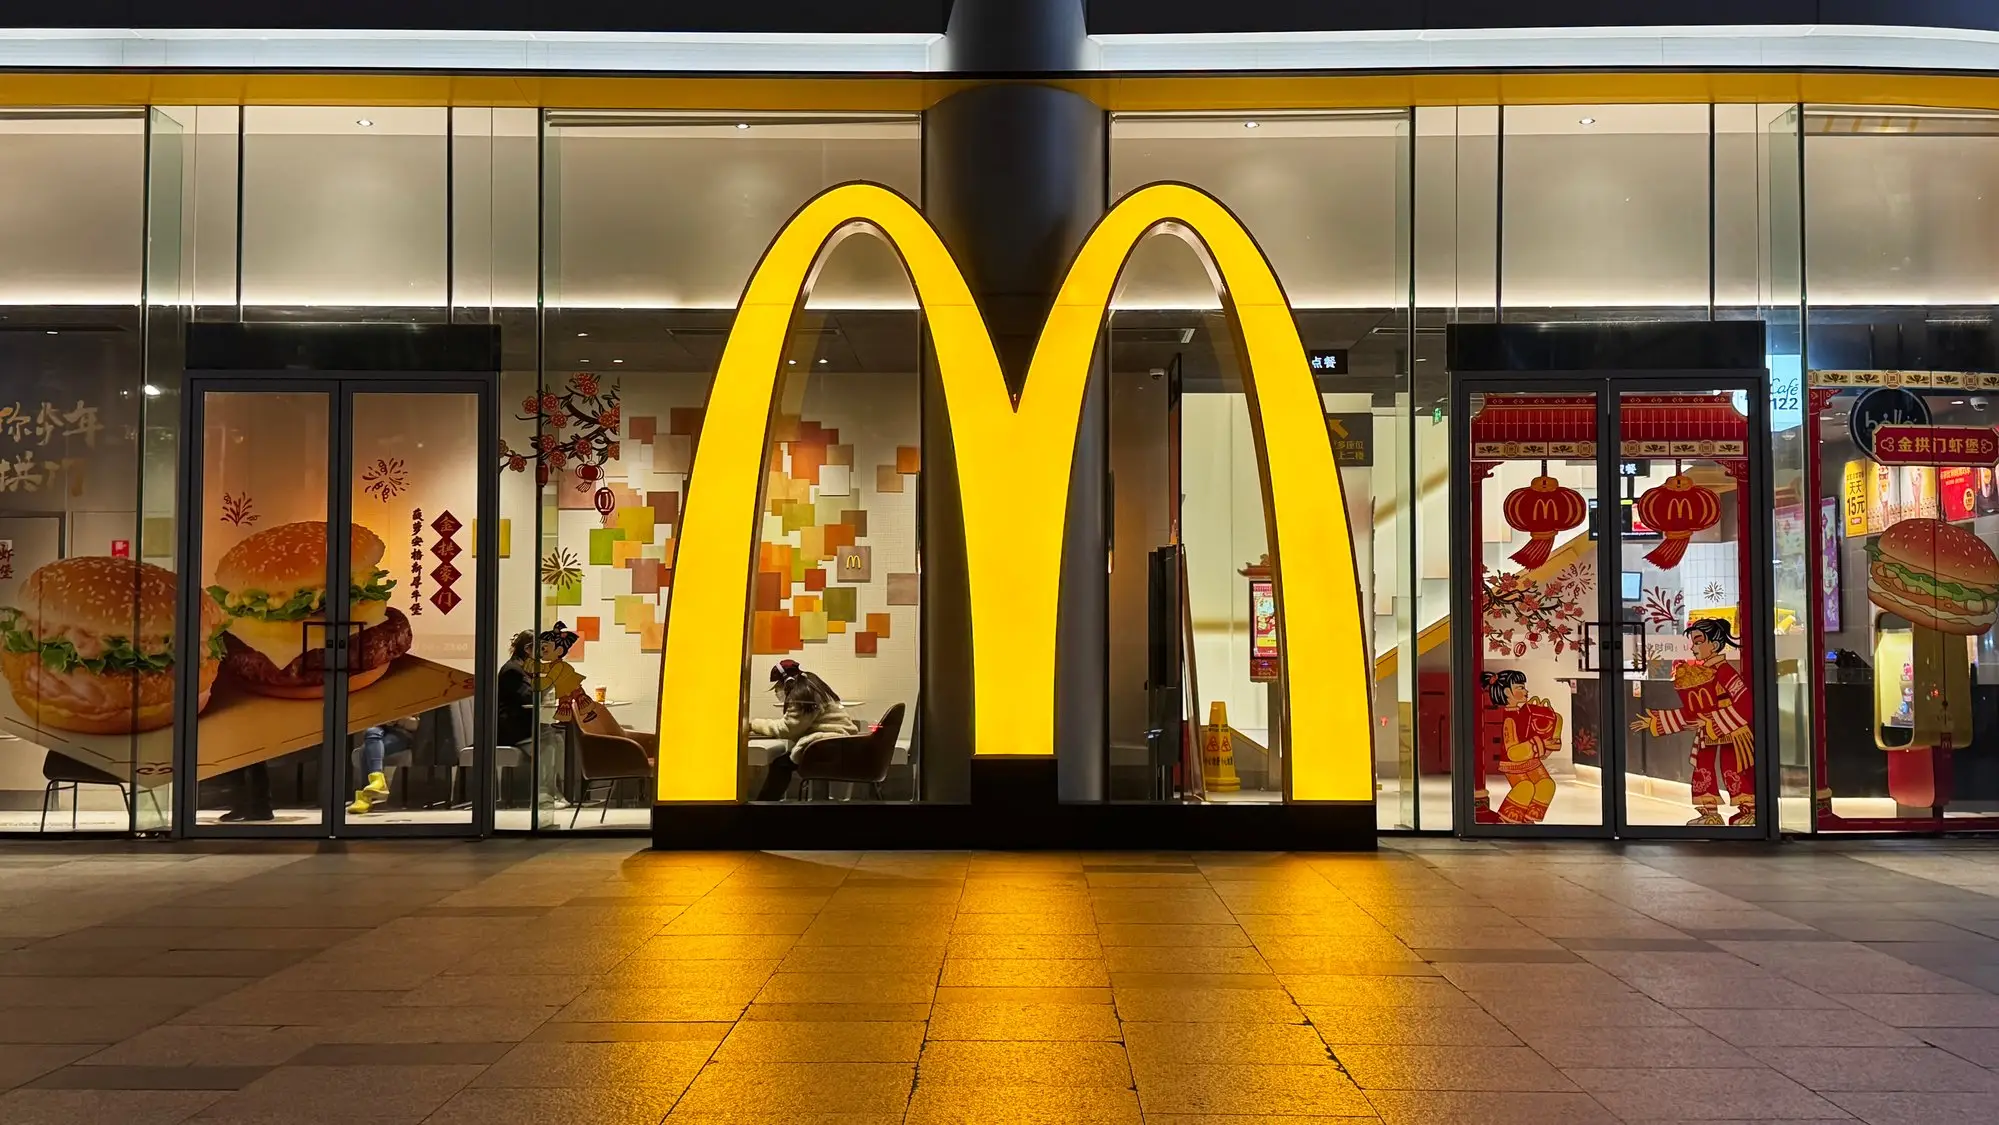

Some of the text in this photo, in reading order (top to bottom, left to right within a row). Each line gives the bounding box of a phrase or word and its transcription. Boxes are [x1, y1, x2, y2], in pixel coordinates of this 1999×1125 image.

[1311, 356, 1337, 369] 点餐
[1897, 436, 1980, 454] 金拱门虾堡
[1847, 495, 1866, 516] 15元
